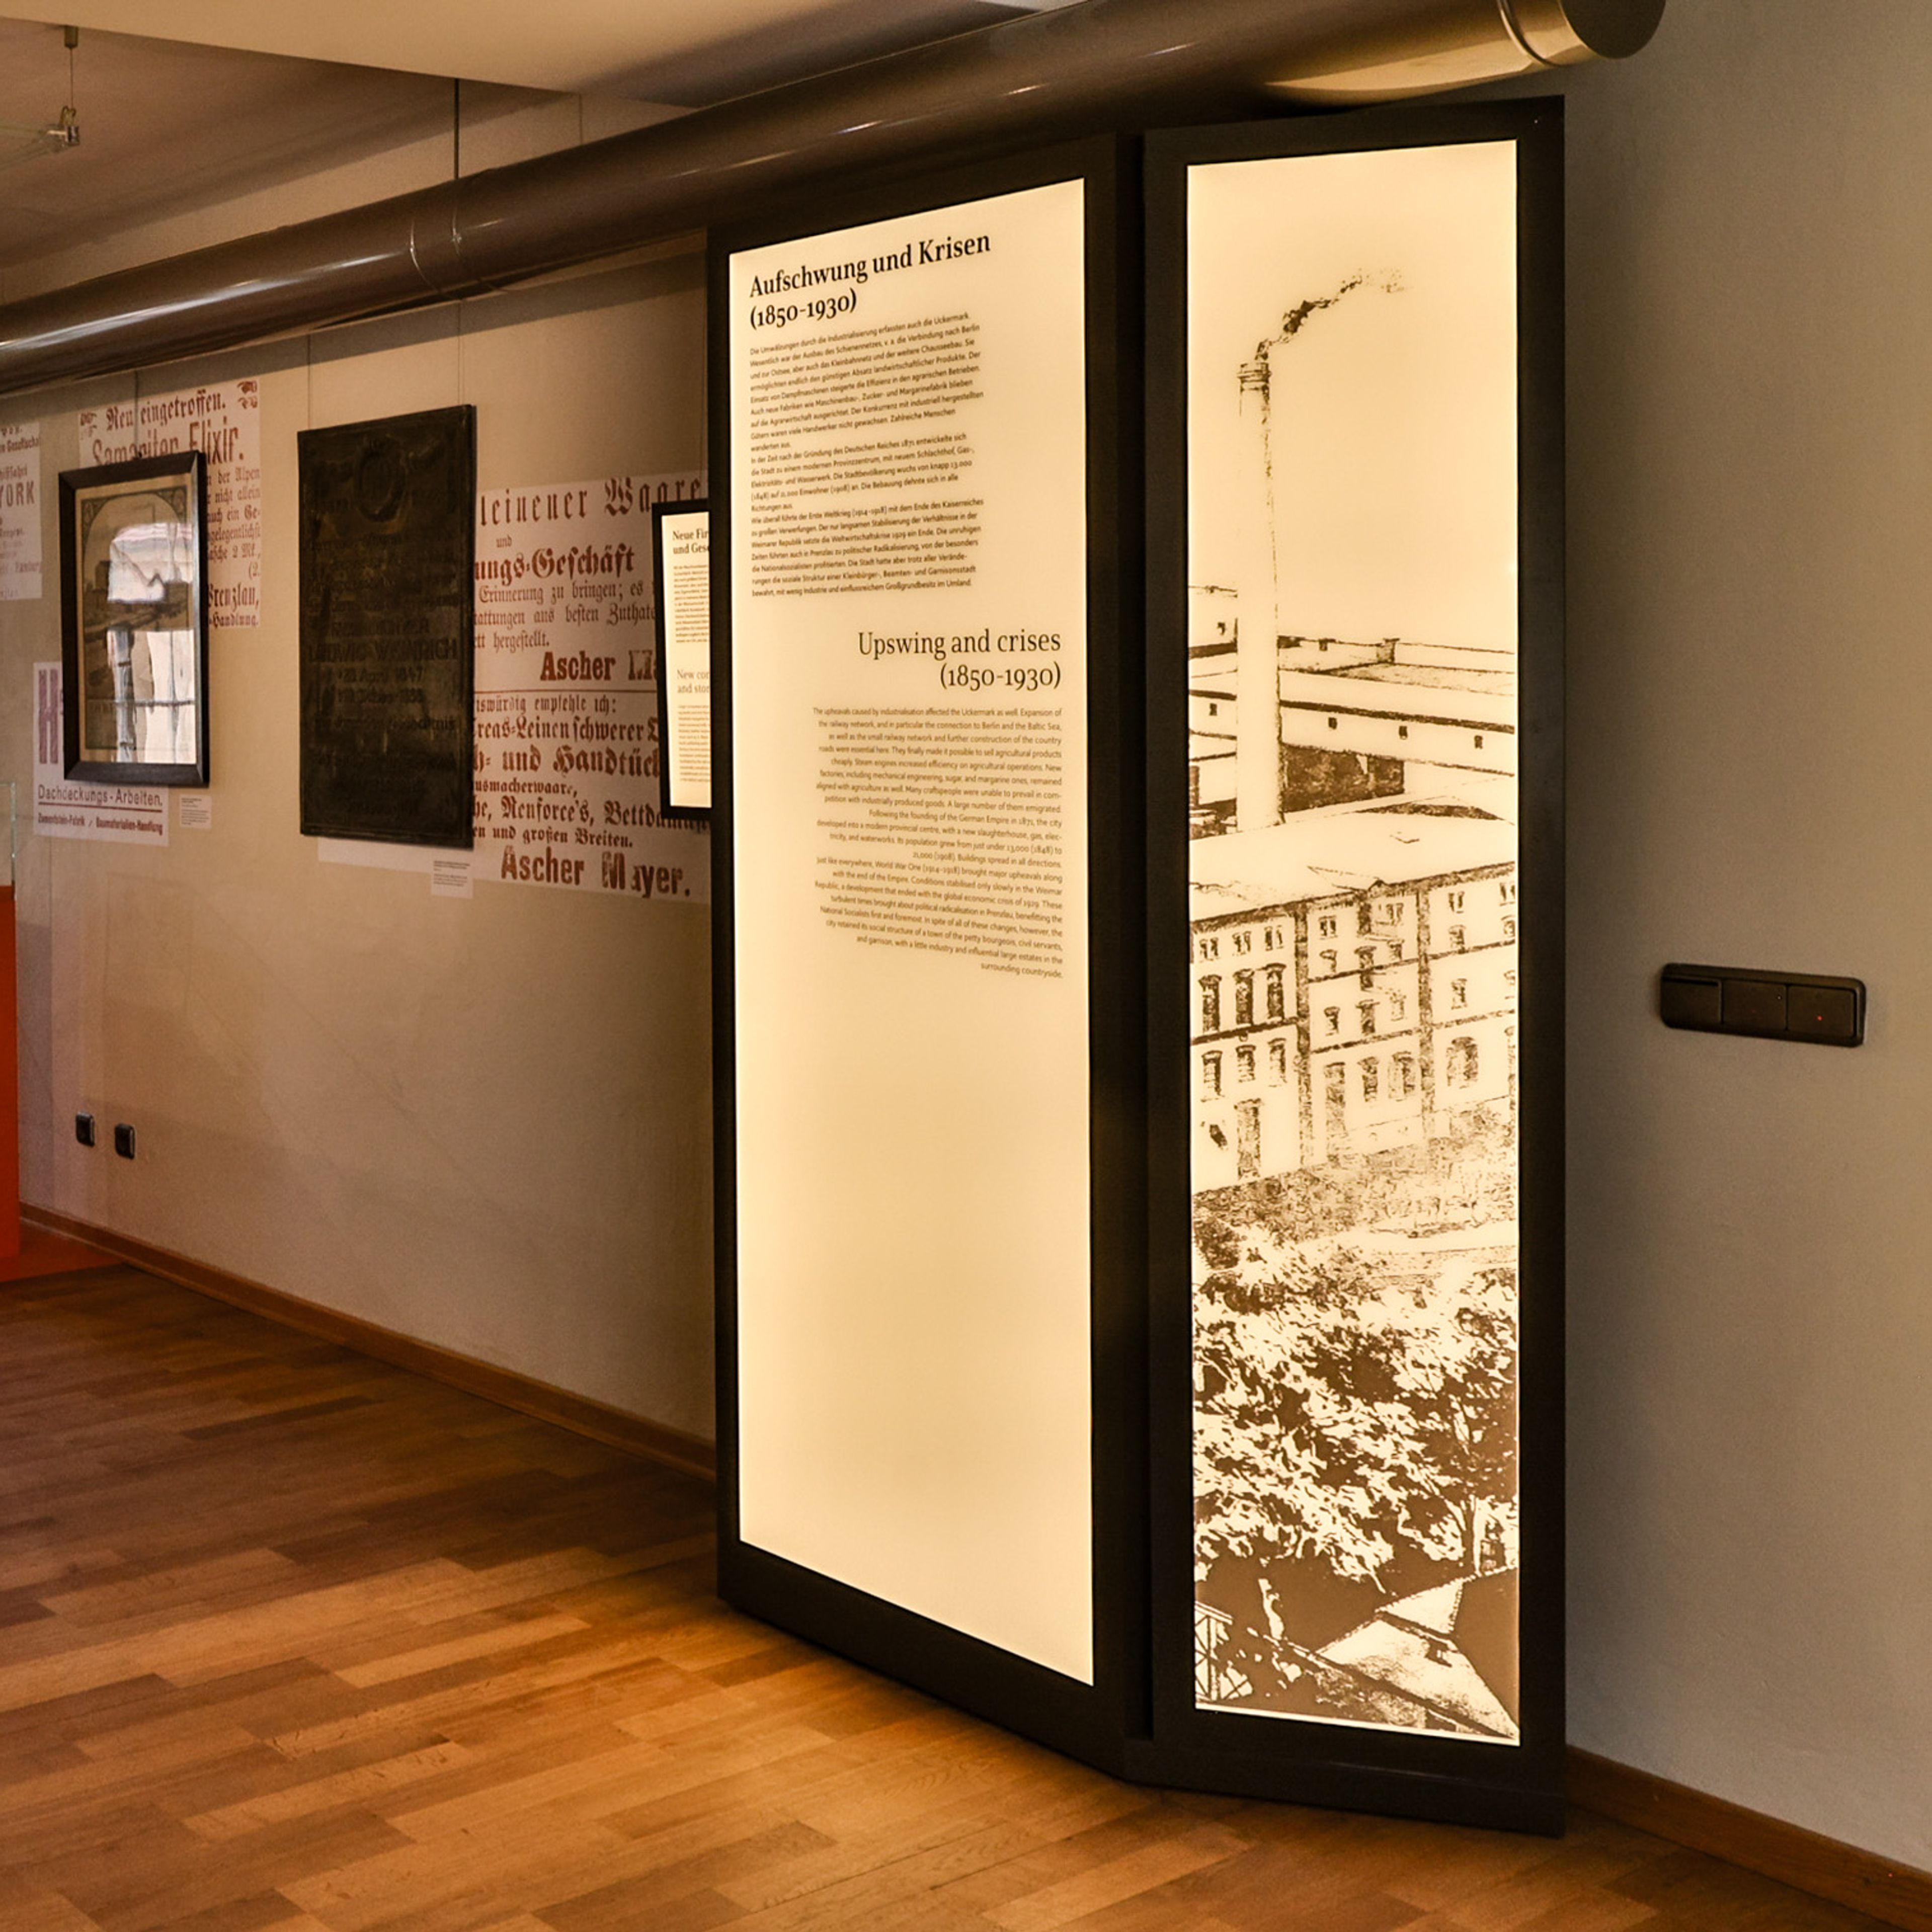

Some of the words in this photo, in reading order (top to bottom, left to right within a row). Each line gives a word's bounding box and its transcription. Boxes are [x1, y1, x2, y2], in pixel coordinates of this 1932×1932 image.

[750, 261, 867, 298] Aufschwung
[873, 244, 912, 273] und
[919, 236, 990, 264] Krisen
[750, 288, 857, 330] (1850-1930)
[107, 406, 134, 431] Neu
[140, 389, 226, 426] eingetroffen.
[189, 416, 245, 466] Elixir.
[496, 535, 512, 548] und
[673, 530, 694, 541] Neue
[673, 544, 689, 554] und
[479, 585, 544, 605] Erinnerung
[551, 585, 564, 603] zu
[630, 586, 643, 596] es
[534, 610, 554, 623] aus
[859, 632, 946, 661] Upswing
[951, 628, 990, 653] and
[998, 629, 1060, 652] crises
[540, 650, 616, 681] Ascher
[677, 670, 694, 679] New
[941, 662, 1060, 691] (1850-1930)
[678, 684, 692, 693] and
[503, 745, 541, 772] und
[493, 826, 516, 839] und
[575, 828, 633, 848] Breiten.
[501, 845, 585, 886] Ascher
